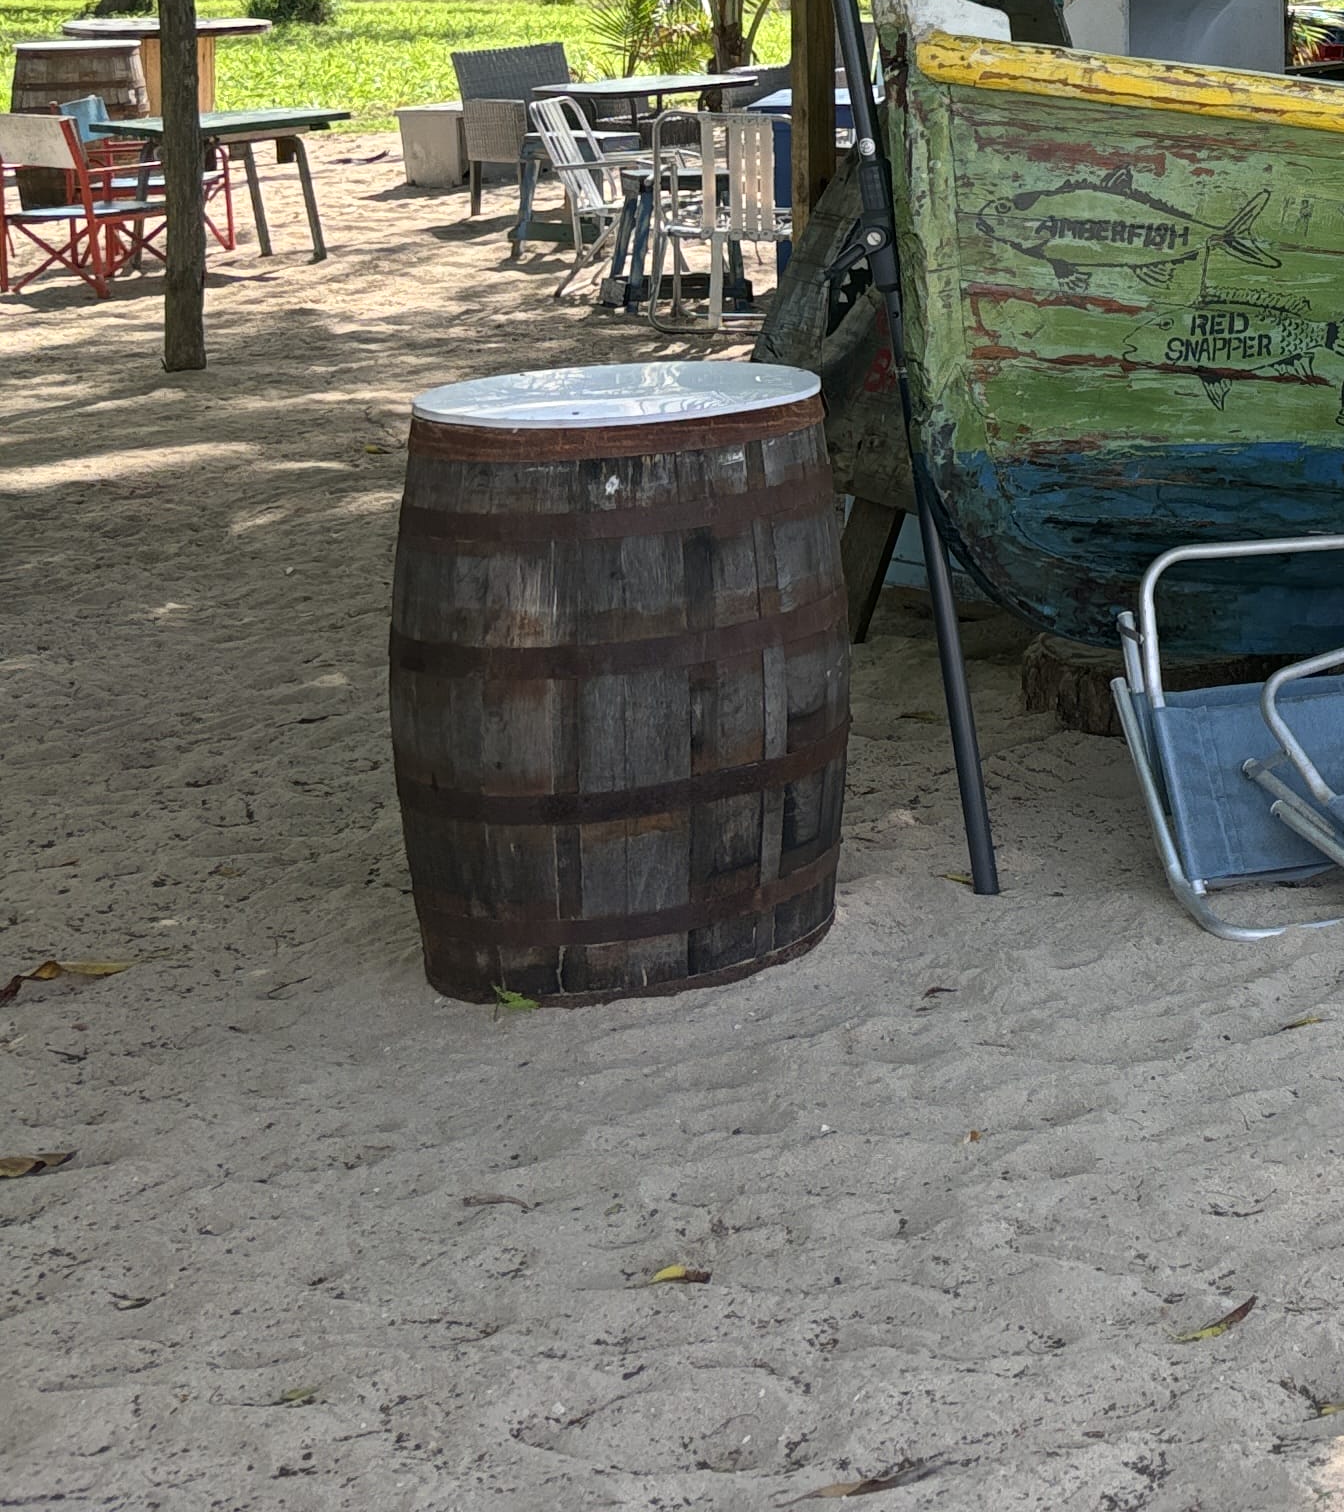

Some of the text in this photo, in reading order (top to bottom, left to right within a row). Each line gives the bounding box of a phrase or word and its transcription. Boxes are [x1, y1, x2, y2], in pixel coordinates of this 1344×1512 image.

[1035, 216, 1190, 250] AMBERFISH
[1190, 312, 1249, 336] RED
[1165, 334, 1272, 362] SNAPPER
